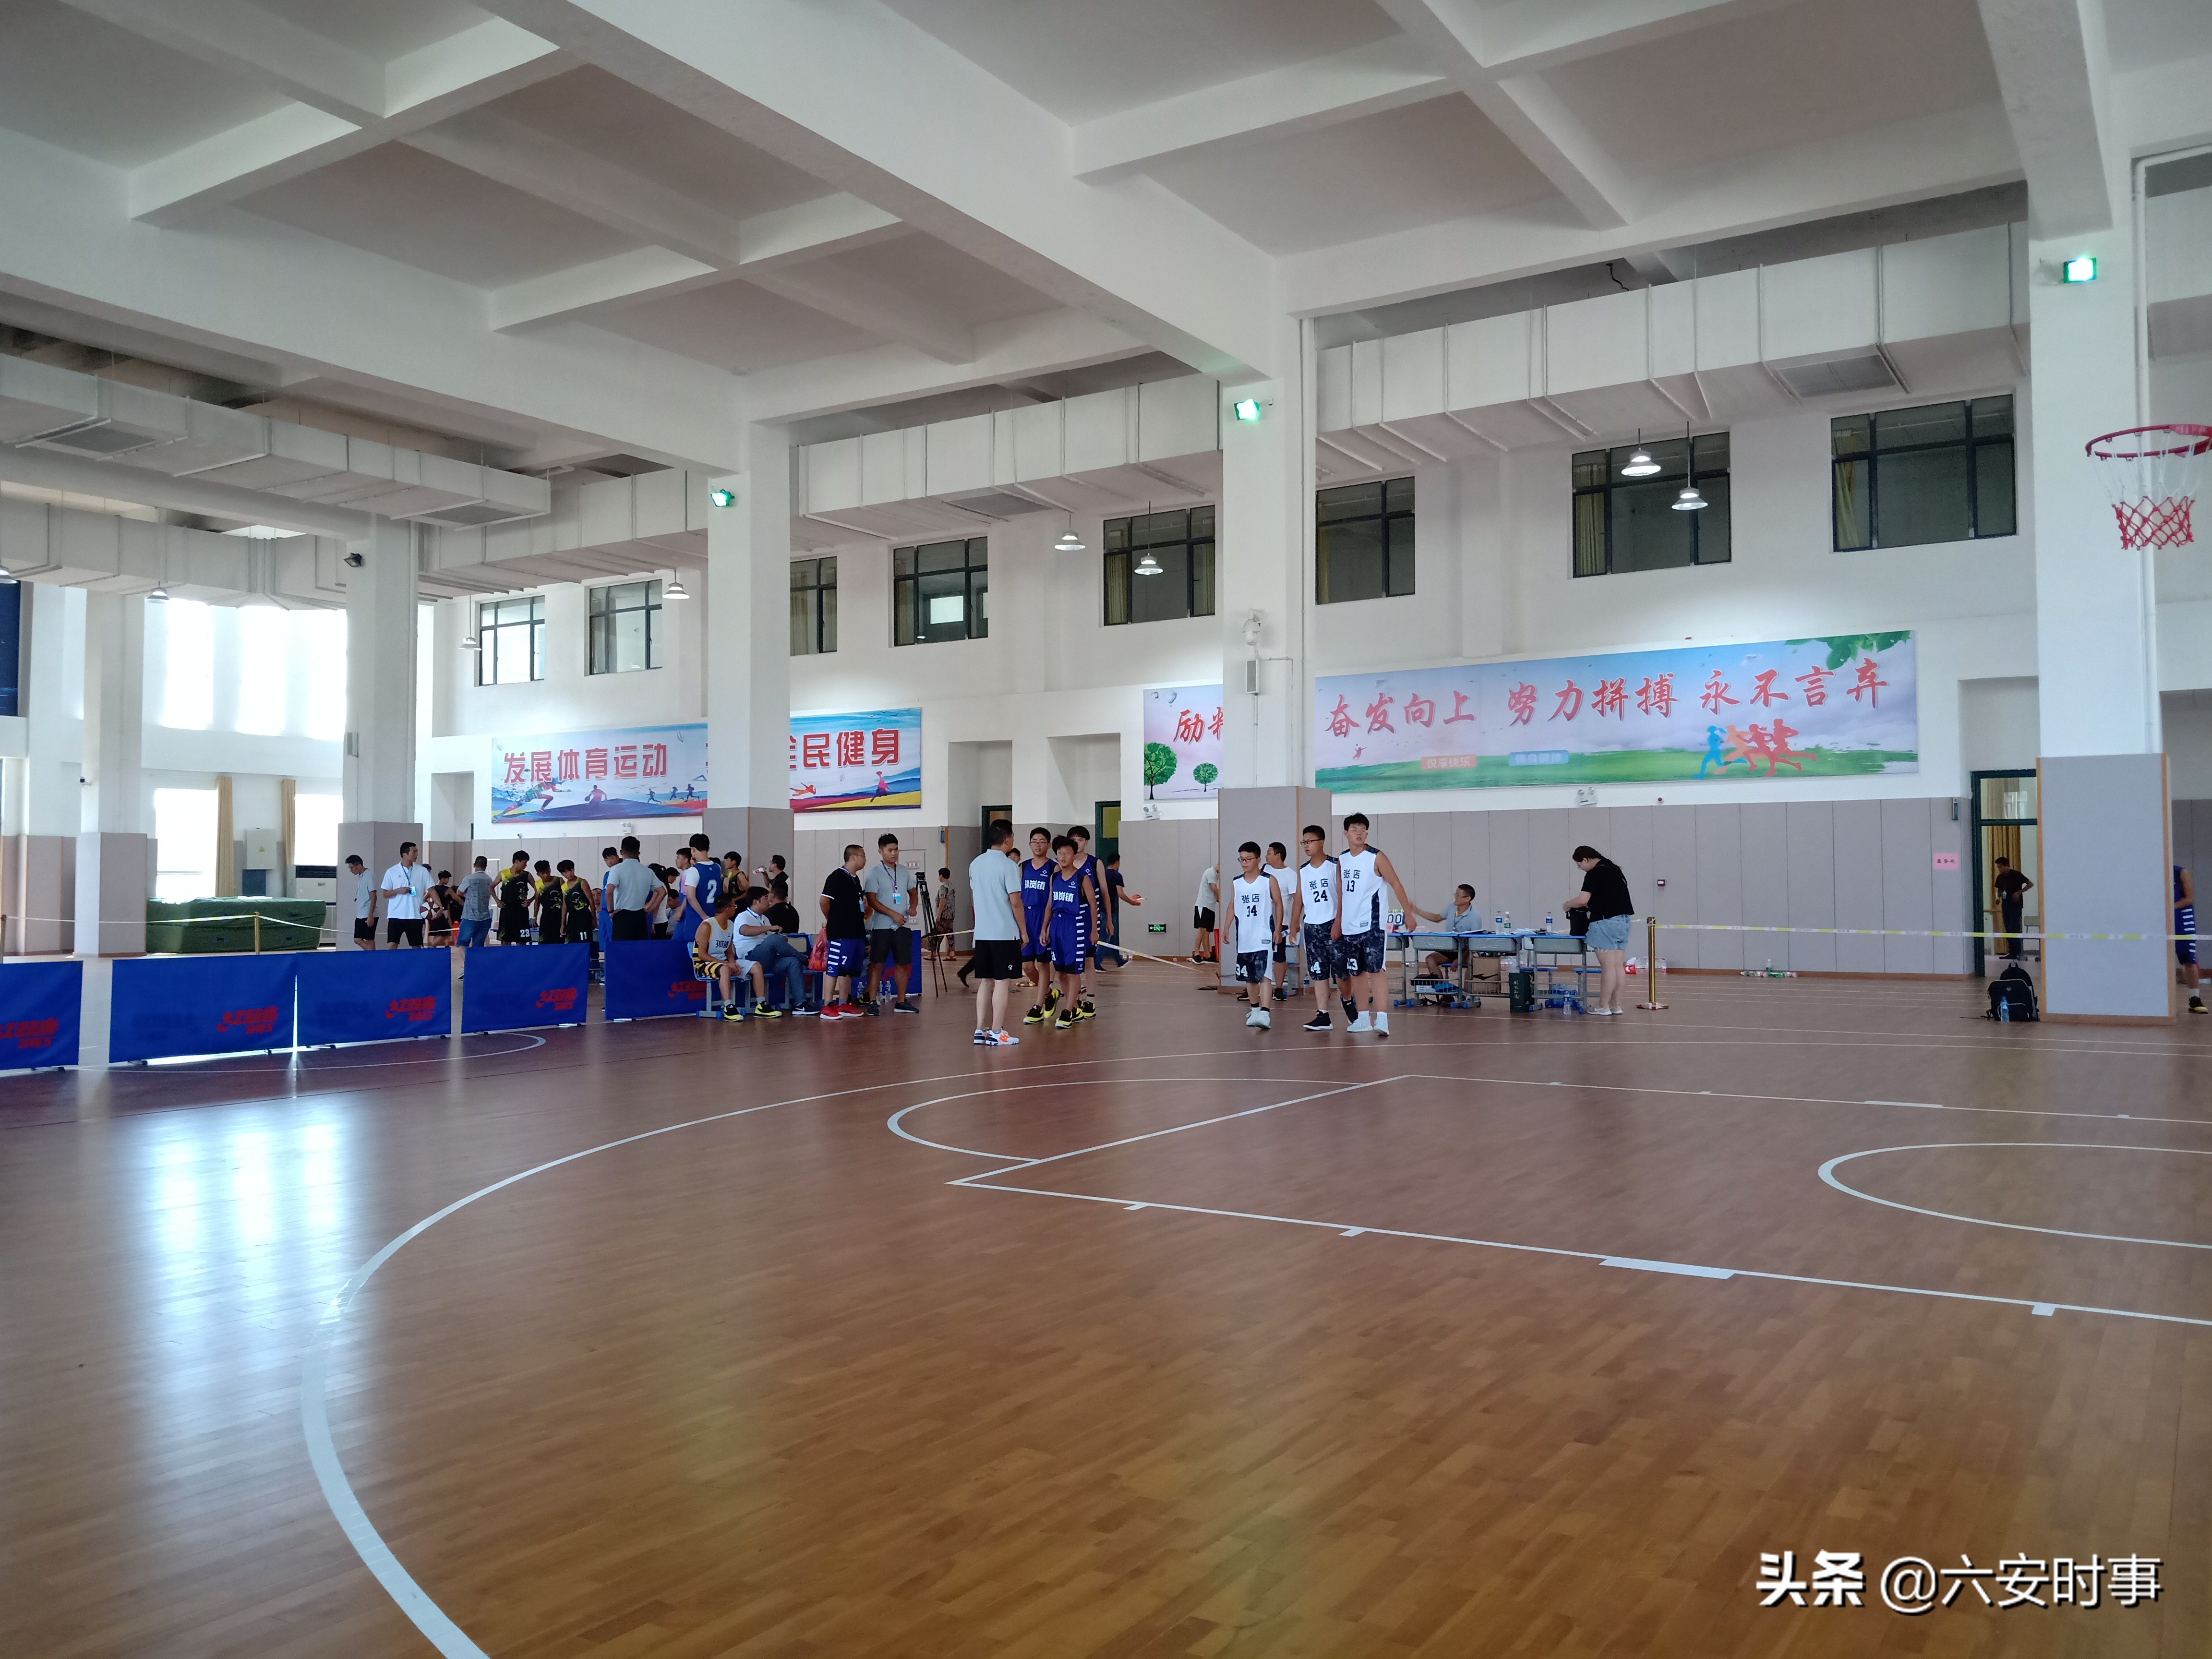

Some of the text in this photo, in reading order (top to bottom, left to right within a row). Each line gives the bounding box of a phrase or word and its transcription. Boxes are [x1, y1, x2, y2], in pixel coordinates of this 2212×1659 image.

[1324, 690, 1475, 738] 奋发向上
[1508, 673, 1679, 727] 努力拼搏
[1699, 657, 1888, 715] 永不言弃
[504, 728, 900, 784] 发展体育运动 民健身
[1427, 757, 1471, 769] 悦享快乐
[1343, 869, 1360, 879] 张店
[1309, 878, 1329, 890] 张店
[1346, 880, 1355, 892] 13
[706, 879, 717, 904] 2
[1313, 890, 1328, 903] 24
[1241, 893, 1260, 903] 张店
[1247, 904, 1257, 917] 34
[520, 929, 530, 938] 23
[579, 931, 587, 940] 11
[842, 955, 848, 965] 7
[1236, 963, 1248, 977] 34
